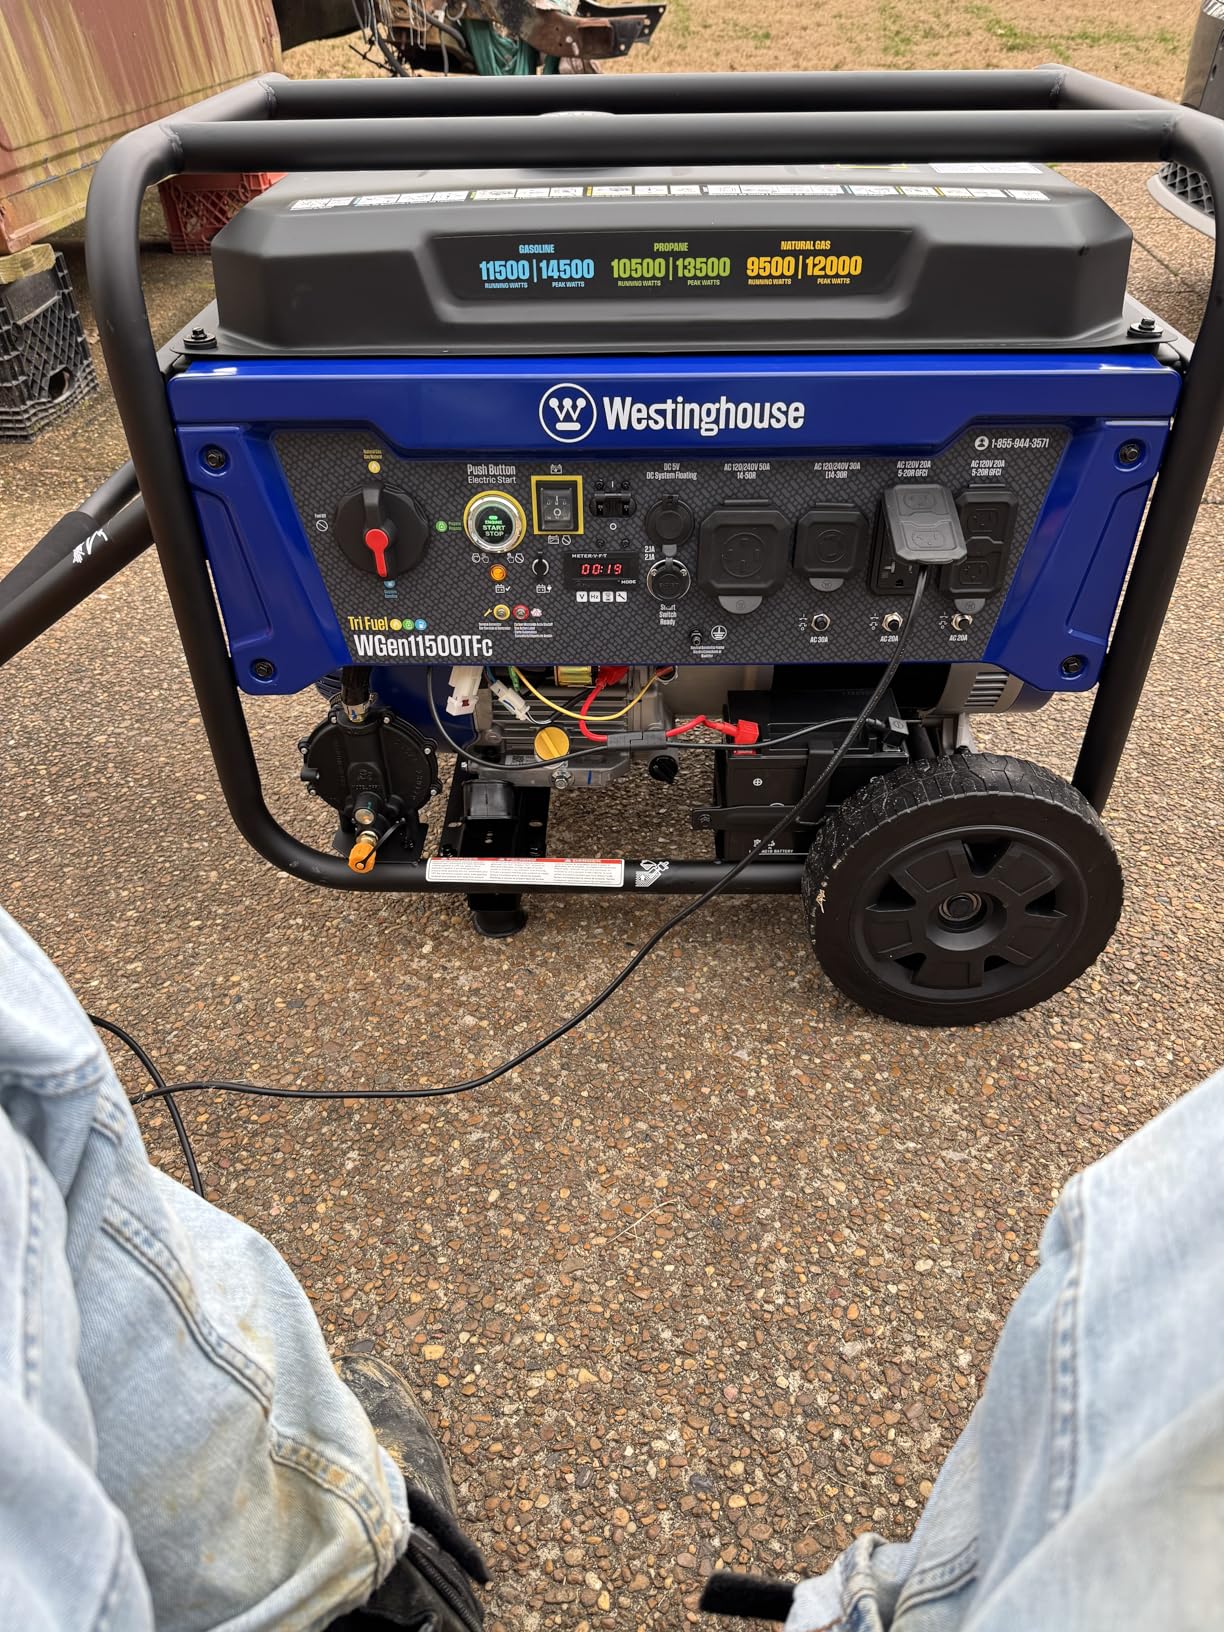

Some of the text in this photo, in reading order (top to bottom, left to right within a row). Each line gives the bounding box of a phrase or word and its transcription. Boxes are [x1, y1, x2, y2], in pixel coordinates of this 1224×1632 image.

[518, 244, 555, 254] GASOLINE
[653, 242, 689, 252] PROPANE
[780, 240, 831, 251] NATURAL GAS
[479, 258, 595, 280] 11500 14500
[610, 257, 731, 278] 10500 13500
[746, 255, 863, 277] 9500 12000
[602, 395, 805, 437] Westinghouse
[990, 437, 1050, 449] 1-855-944-3571
[663, 463, 680, 471] DC 5V
[723, 462, 770, 471] AC 120/240V 50A
[813, 462, 861, 470] AC 120/240V 30A
[896, 461, 905, 469] AC
[919, 460, 931, 468] 20A
[970, 459, 1005, 468] AC 120V 20A
[467, 464, 516, 475] Push Button
[825, 470, 848, 479] L14-30R
[897, 469, 928, 477] 5-20R GFCI
[971, 468, 1002, 477] 5-20R GFCI
[467, 476, 517, 484] Electric Start
[646, 471, 697, 481] DC System Floating
[737, 471, 757, 480] 14-50R
[581, 563, 622, 575] 00:19
[347, 616, 388, 631] Tri Fuel
[659, 618, 676, 627] Ready
[949, 634, 957, 642] AC
[353, 634, 493, 657] WGen11500TFc
